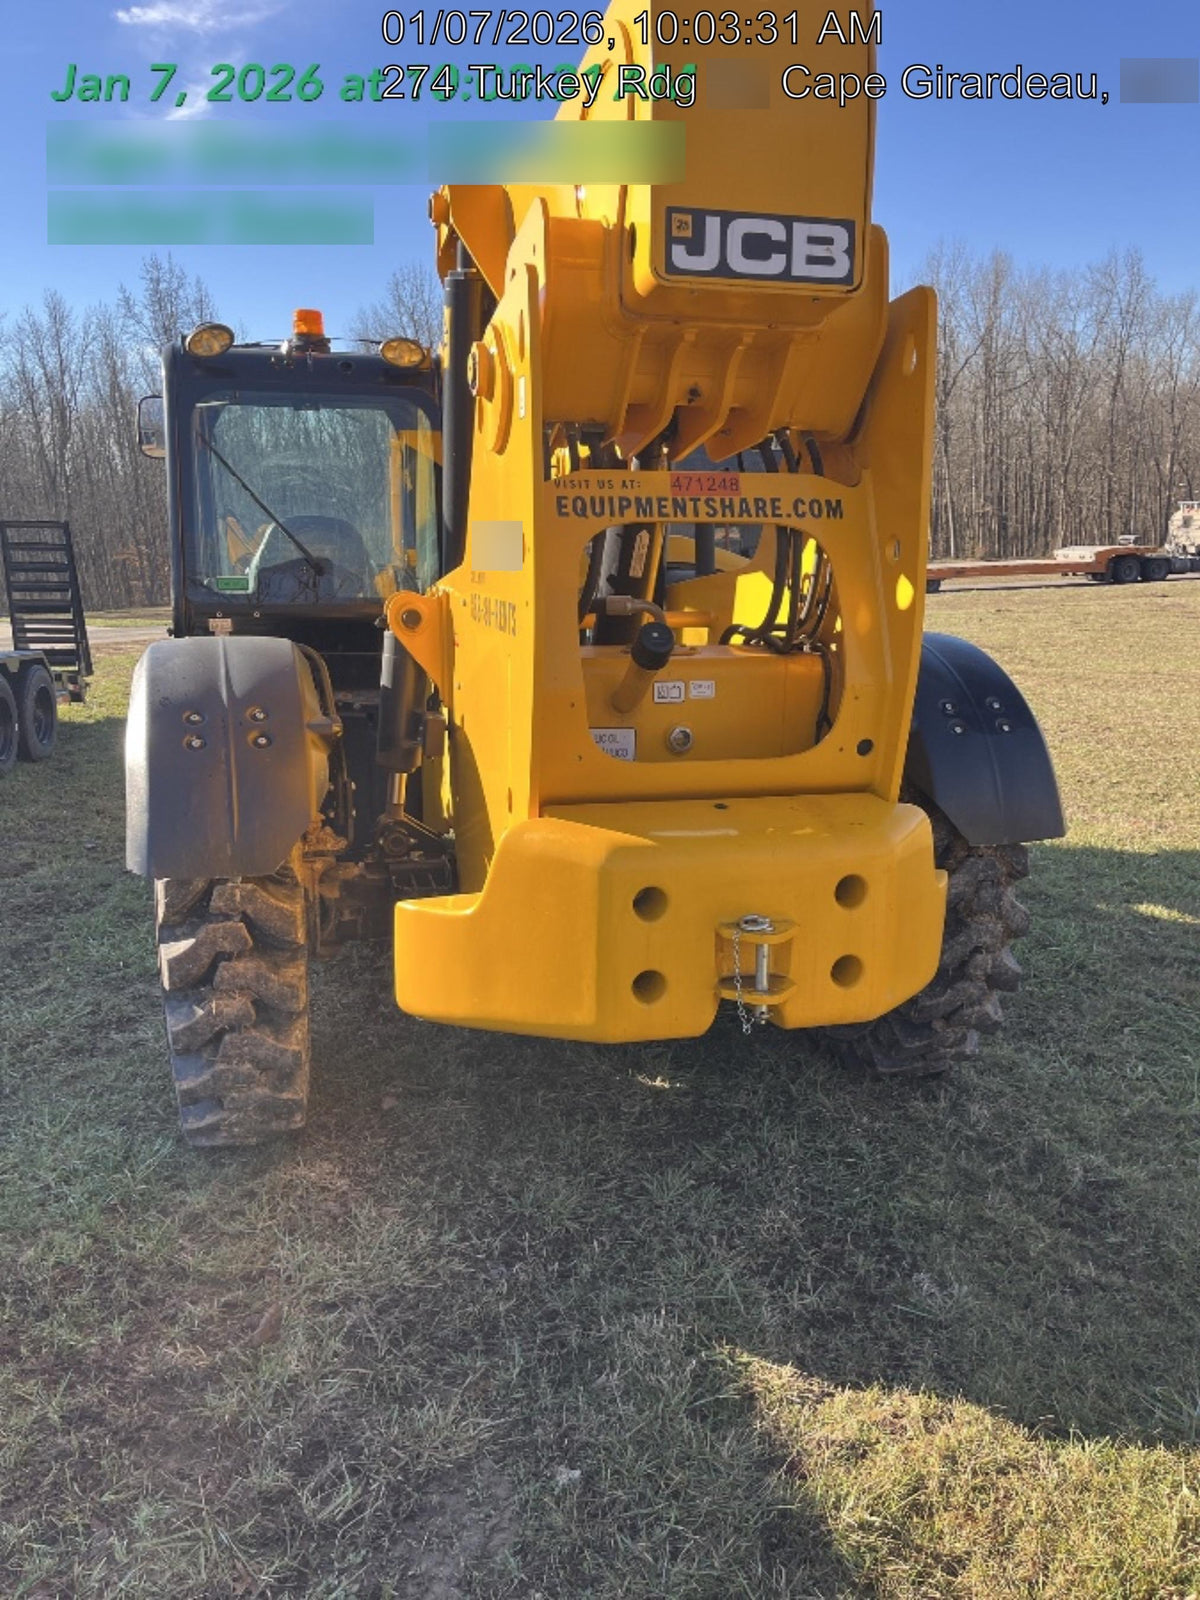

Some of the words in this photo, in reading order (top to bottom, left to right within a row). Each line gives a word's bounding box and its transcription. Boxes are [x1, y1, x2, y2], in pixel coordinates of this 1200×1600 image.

[672, 215, 850, 278] JCB
[554, 478, 590, 489] VISIT
[597, 479, 615, 490] US
[621, 479, 641, 490] AT:
[555, 495, 844, 519] EQUIPMENTSHARE.COM
